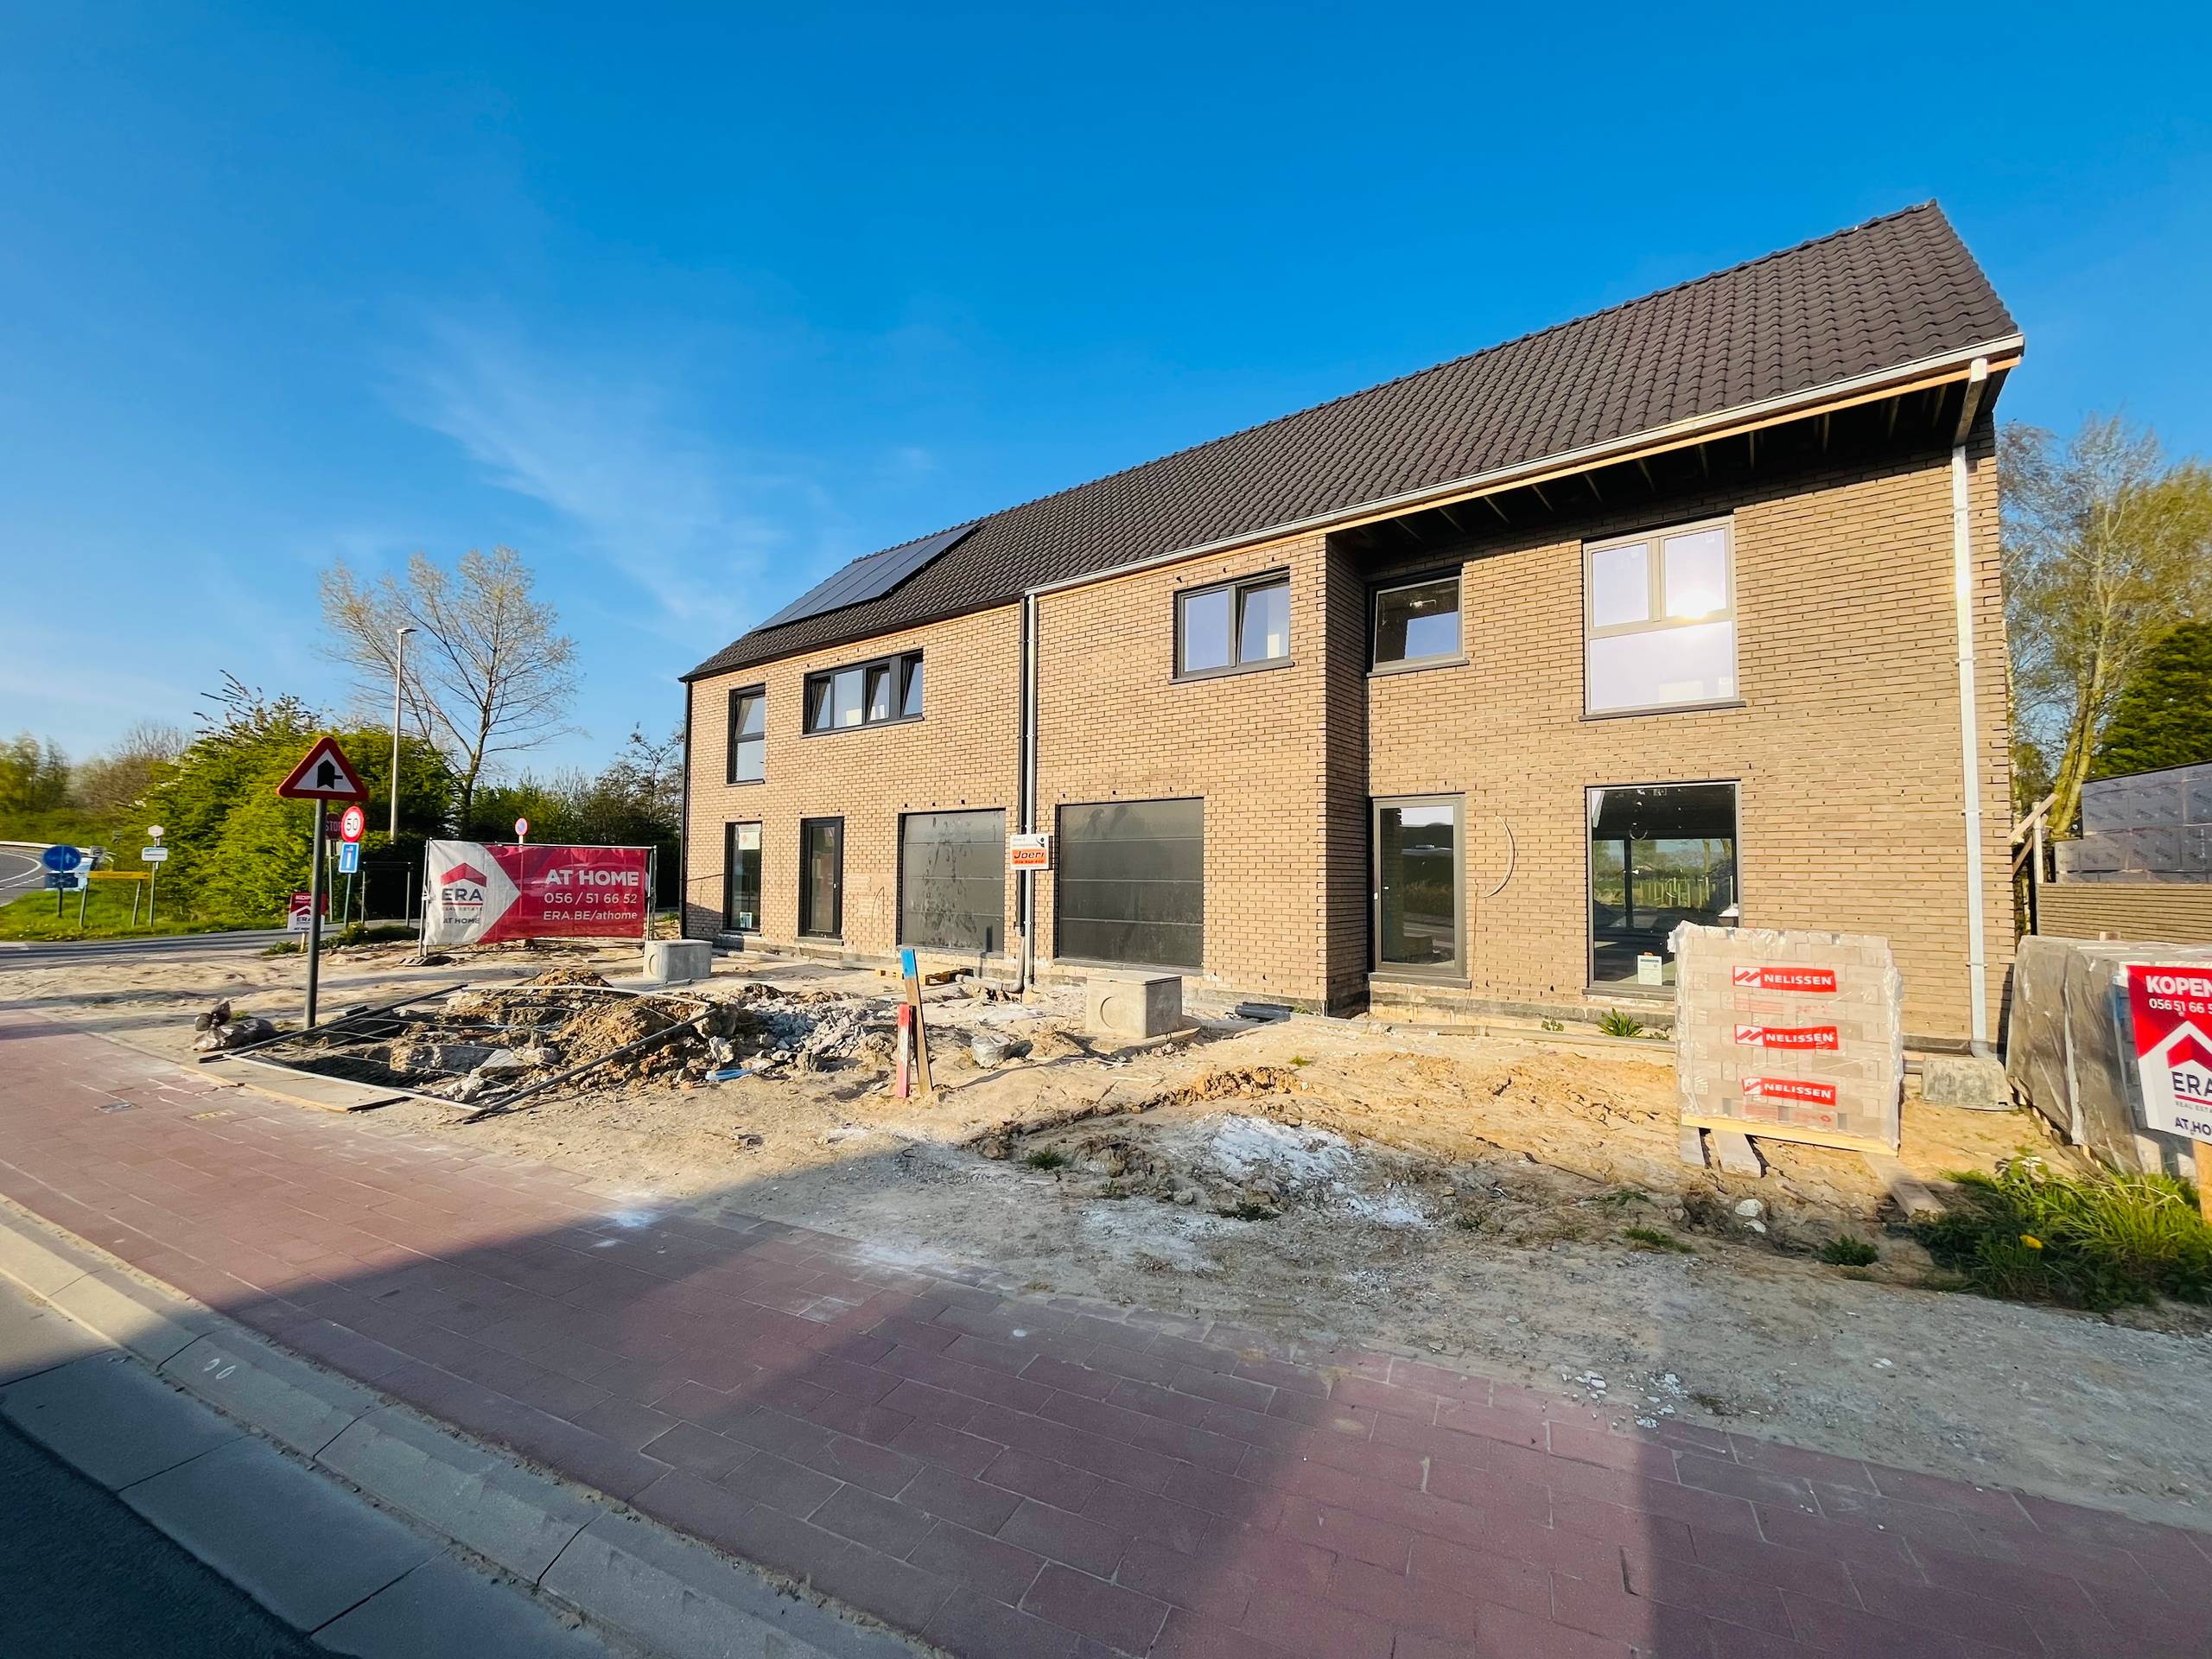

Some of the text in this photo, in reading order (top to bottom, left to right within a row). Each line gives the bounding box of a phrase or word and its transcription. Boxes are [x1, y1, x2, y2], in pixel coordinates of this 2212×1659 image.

[346, 817, 359, 831] 50
[545, 869, 639, 886] AT HOME
[442, 887, 483, 901] ERA
[543, 891, 638, 906] 056 / 51 66 52
[543, 910, 638, 922] ERA.BE/athome
[1764, 974, 1832, 985] NELISSEN
[2149, 998, 2172, 1010] 056
[2173, 1001, 2186, 1012] 51
[2189, 1001, 2205, 1014] 66
[1765, 1033, 1834, 1043] NELISSEN
[1764, 1084, 1831, 1098] NELISSEN
[2175, 1116, 2189, 1129] AT
